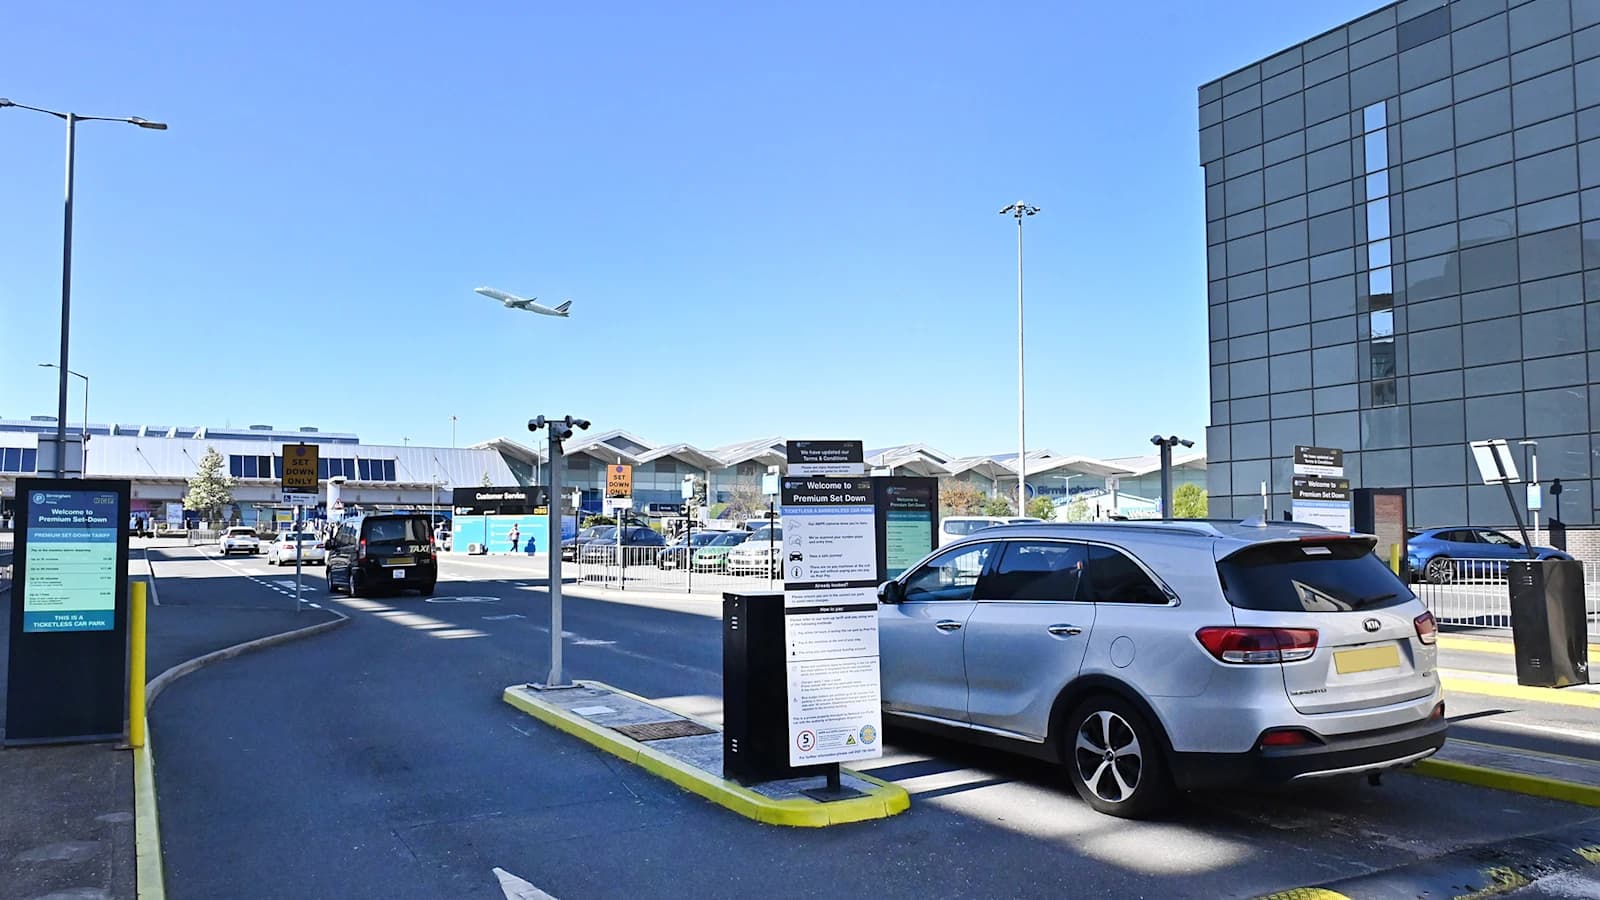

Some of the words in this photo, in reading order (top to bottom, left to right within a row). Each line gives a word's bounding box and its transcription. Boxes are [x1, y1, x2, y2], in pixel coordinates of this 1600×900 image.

[807, 482, 842, 490] Welcome
[844, 482, 852, 490] to
[476, 492, 504, 500] Customer
[504, 492, 526, 500] Service
[1300, 490, 1322, 498] Premium
[409, 545, 430, 553] TAXI
[1366, 622, 1380, 630] KIA
[803, 734, 809, 744] 5
